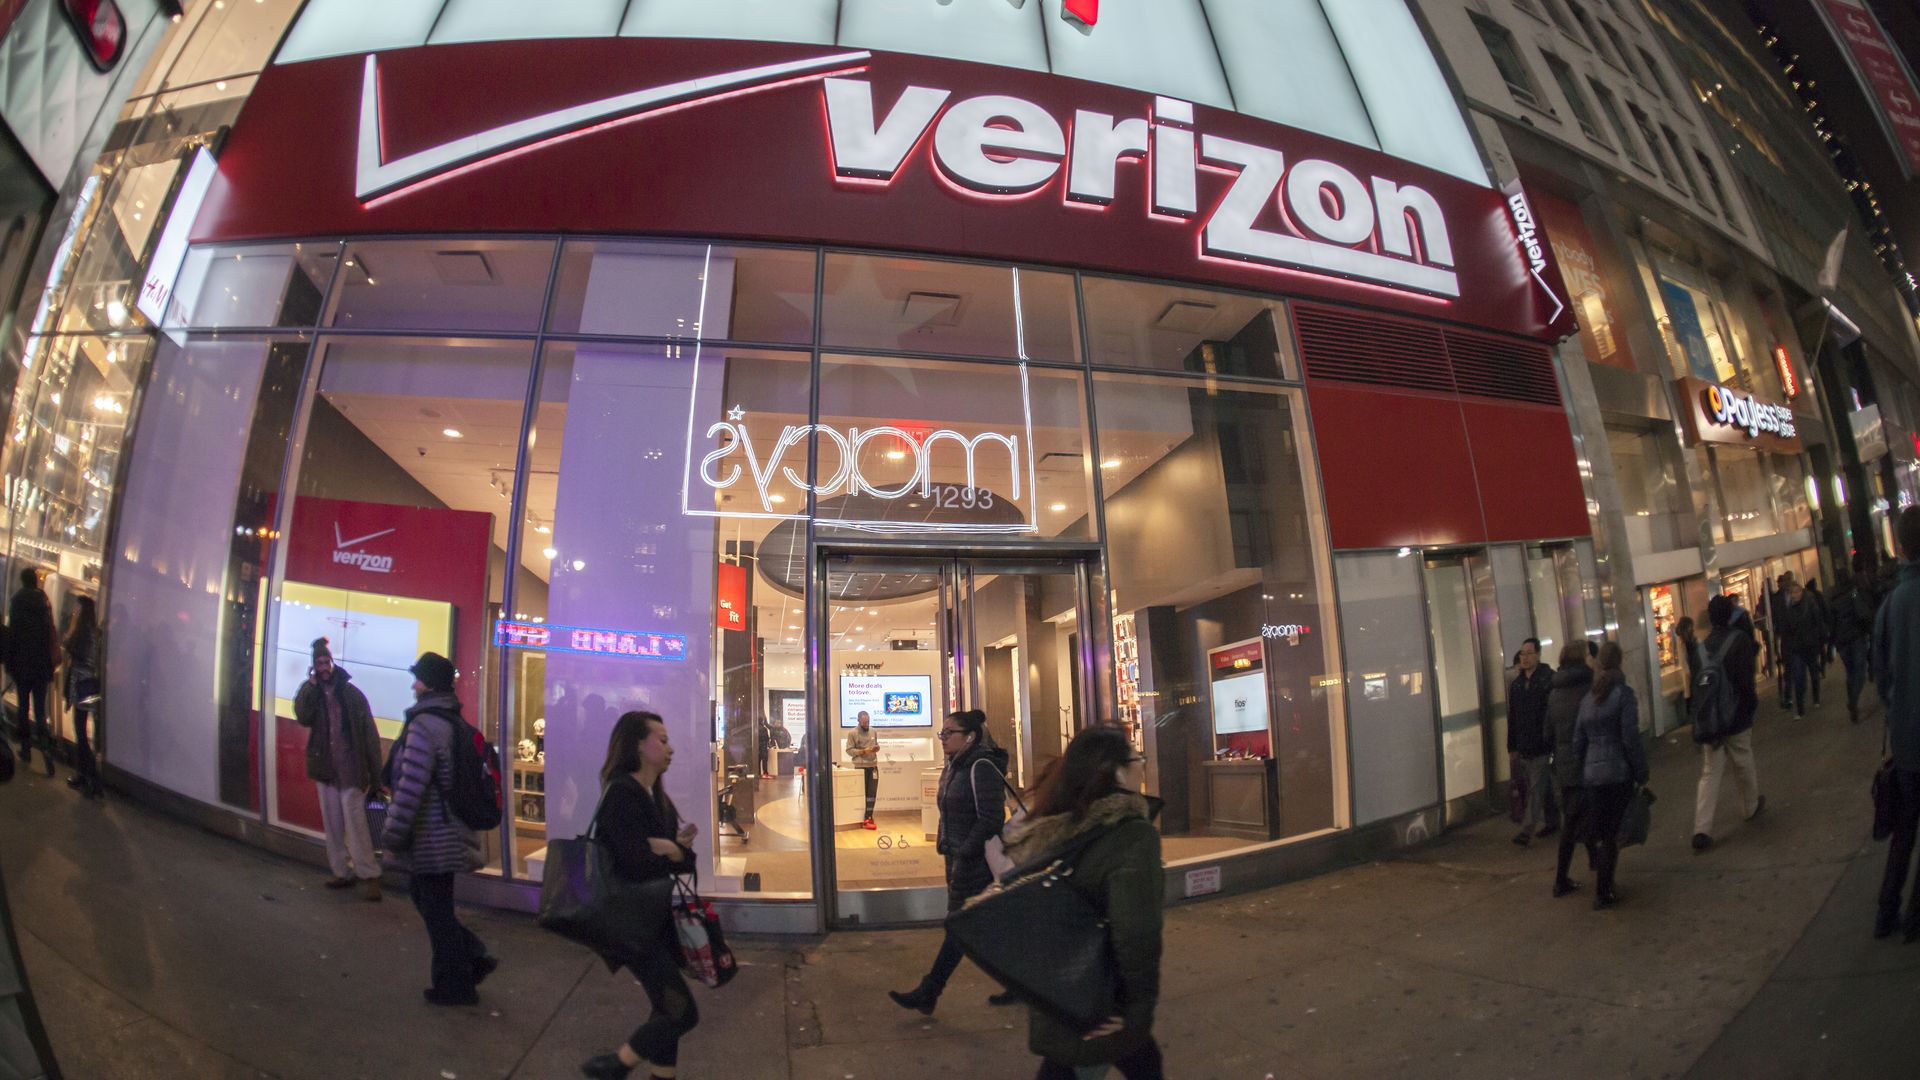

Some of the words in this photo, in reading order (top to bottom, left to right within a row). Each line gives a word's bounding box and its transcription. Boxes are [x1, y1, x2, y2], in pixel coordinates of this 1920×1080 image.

[822, 77, 1460, 300] verizon
[1508, 192, 1547, 274] verizon
[1720, 387, 1780, 438] Payless
[931, 485, 994, 511] 1293
[332, 549, 393, 573] verizon
[720, 599, 732, 609] Get
[729, 610, 740, 623] fit
[845, 662, 881, 670] welcome
